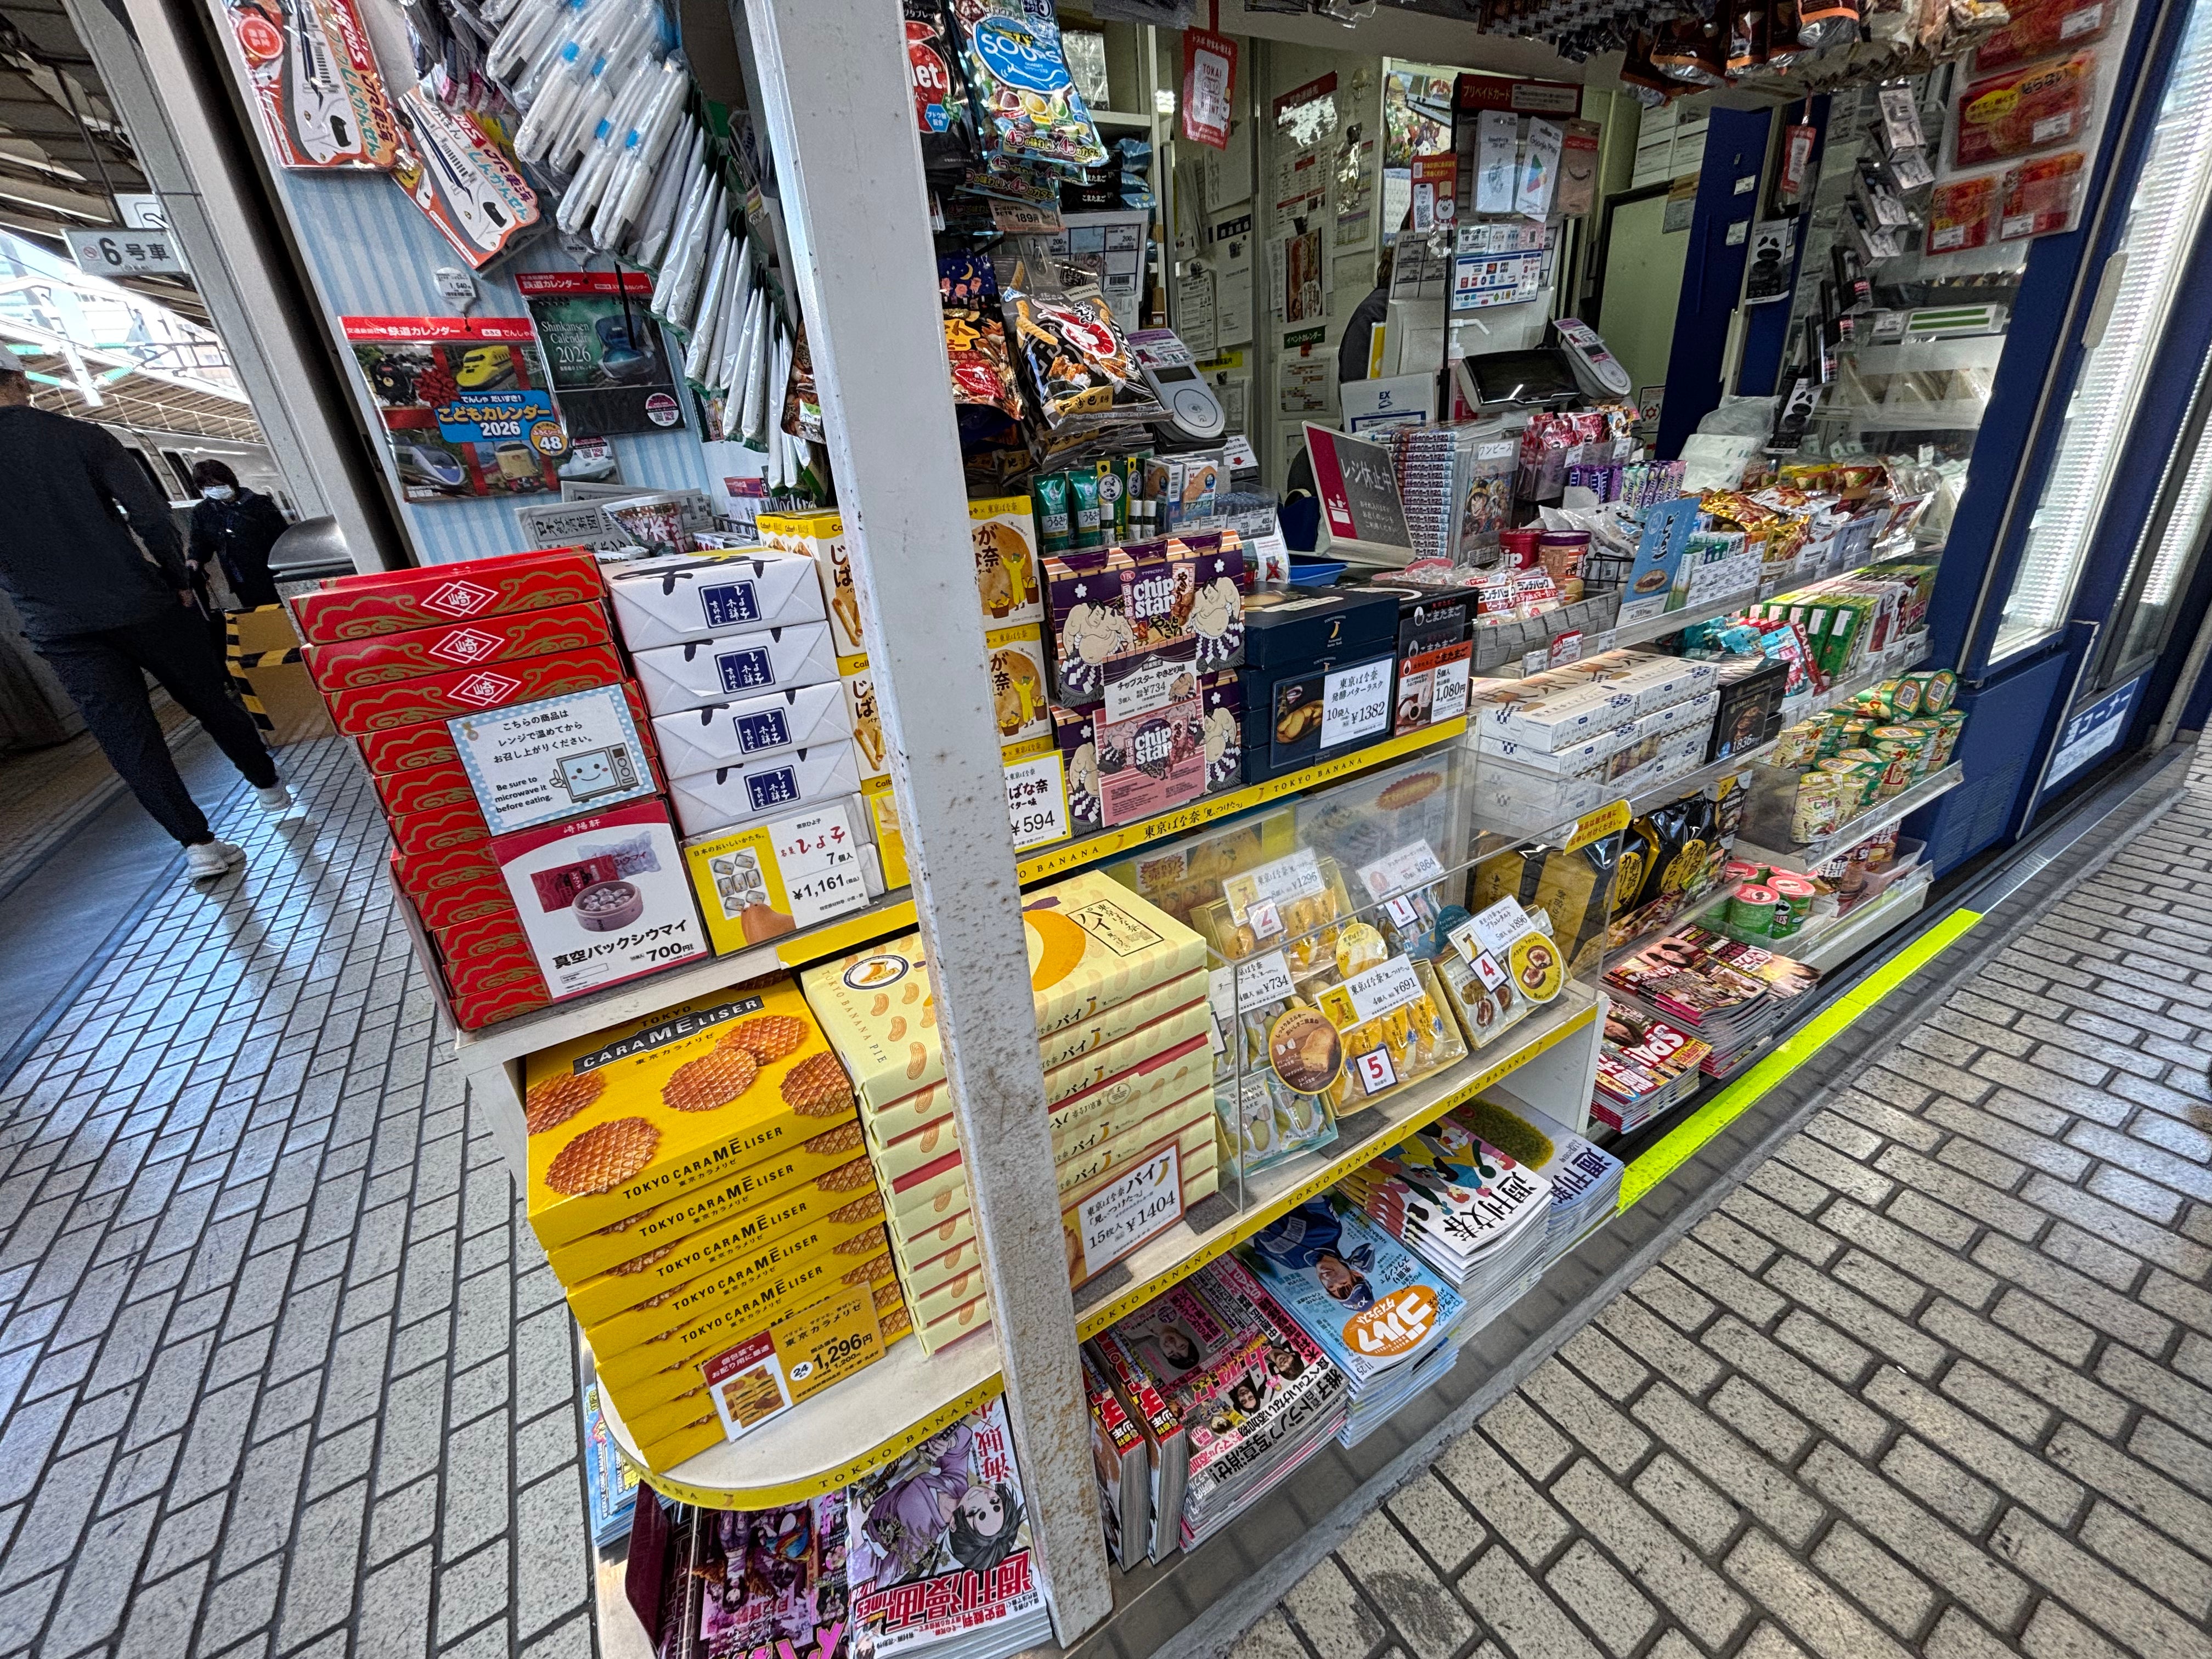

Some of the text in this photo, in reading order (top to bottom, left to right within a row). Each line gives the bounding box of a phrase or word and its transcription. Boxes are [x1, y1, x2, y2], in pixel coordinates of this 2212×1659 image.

[341, 67, 381, 157] しんかんせん
[361, 74, 395, 143] JR東海
[468, 151, 527, 220] しんかんせん
[484, 149, 533, 202] JR東海
[99, 238, 171, 266] 6号車
[523, 280, 580, 289] 鉄道カレンダー
[388, 327, 461, 336] 鉄道カレンダー
[541, 321, 589, 331] Shinkansen
[550, 333, 588, 343] Calendar
[1286, 332, 1322, 344] イベントカレンダー
[556, 347, 591, 363] 2026
[1379, 391, 1390, 400] EX
[438, 404, 550, 422] こどもカレンダー
[480, 422, 521, 436] 2026
[540, 437, 562, 450] 48
[1479, 443, 1513, 456] ワンピース
[1341, 459, 1392, 493] レジ休止中
[1133, 576, 1175, 601] chip
[1479, 586, 1515, 601] ランチパック
[1517, 579, 1549, 591] ランチパック
[1135, 595, 1176, 619] star
[1486, 600, 1515, 611] ピーナッツ
[1118, 665, 1186, 690] チップスター やきとり味
[1340, 667, 1378, 689] 東京ばな奈
[1437, 668, 1451, 678] 8個入
[1143, 681, 1166, 695] ¥734
[1331, 680, 1384, 703] 発酵バターラスク
[1436, 681, 1466, 703] 1,080円
[1118, 696, 1131, 705] 3個入
[503, 710, 569, 730] こちらの商品は
[1327, 708, 1350, 721] 10袋入
[1351, 701, 1385, 724] ¥1382
[498, 722, 582, 747] レンジで温めてから
[1135, 727, 1172, 749] chip
[493, 736, 592, 763] お召し上がりください。
[1136, 741, 1173, 765] star
[509, 780, 526, 789] sure
[1009, 768, 1035, 779] 東京ばな奈
[1274, 757, 1362, 792] TOKYO BANANA
[495, 788, 539, 803] microwave
[1009, 778, 1048, 800] ばな奈
[496, 796, 552, 812] before eating.
[563, 819, 601, 833] 崎陽軒
[797, 819, 821, 829] 東京ひよ子
[1012, 810, 1055, 836] ¥594
[1143, 808, 1200, 838] 東京ばな奈
[693, 834, 764, 857] 日本のおいしいかたち。
[795, 826, 845, 854] ひよ子
[1037, 847, 1099, 872] BANANA
[1417, 857, 1436, 873] ¥864
[792, 874, 844, 900] ¥1,161
[1291, 872, 1317, 889] ¥1296
[1077, 907, 1111, 931] パイ
[1510, 915, 1528, 930] ¥896
[552, 919, 686, 969] 真空パックシウマイ
[1481, 959, 1494, 977] 4
[1263, 974, 1289, 991] ¥734
[1350, 975, 1384, 995] 東京ばな奈
[1393, 978, 1417, 994] ¥691
[1373, 995, 1387, 1005] 4個入
[642, 1006, 691, 1026] TOKYO
[822, 970, 888, 1064] TOKYO BANANA PIE
[1055, 1009, 1081, 1029] パイ
[636, 1034, 714, 1065] 東京カラメリゼ
[1061, 1040, 1086, 1061] パイ
[1624, 1025, 1684, 1066] SPA!
[1367, 1057, 1384, 1079] 5
[1064, 1077, 1090, 1097] パイ
[1446, 1054, 1527, 1108] TOKYO BANANA
[1071, 1136, 1095, 1155] パイ
[679, 1159, 737, 1187] 東京カラメリゼ
[1074, 1163, 1097, 1183] パイ
[1288, 1139, 1388, 1206] TOKYO BANANA
[623, 1176, 670, 1199] TOKYO
[1087, 1164, 1155, 1217] 東京ばな奈 パイ
[693, 1196, 749, 1224] 東京カラメリゼ
[1126, 1190, 1175, 1232] ¥1404
[1443, 1171, 1538, 1242] 週刊文春
[639, 1213, 685, 1237] TOKYO
[1089, 1223, 1123, 1249] 15枚入
[709, 1234, 763, 1262] 東京カラメリゼ
[656, 1253, 700, 1277] TOKYO
[723, 1266, 776, 1295] 東京カラメリゼ
[1086, 1295, 1139, 1332] TOKYO
[1149, 1250, 1212, 1292] BANANA
[672, 1286, 715, 1310] TOKYO
[730, 1299, 782, 1328] 東京カラメリゼ
[785, 1303, 861, 1347] 東京カラメリゼ
[1358, 1293, 1432, 1352] ゴルフ
[680, 1318, 722, 1343] TOKYO
[712, 1346, 769, 1379] お配り用に最適
[721, 1344, 754, 1364] 個包装で
[814, 1333, 873, 1369] 1,296円
[793, 1364, 809, 1377] 24
[1317, 1368, 1344, 1404] 雅子
[820, 1390, 989, 1489] TOKYO BANANA
[887, 1550, 1035, 1633] 週刊漫画
[856, 1590, 895, 1620] TIMES
[963, 1603, 1007, 1629] 歴史裁判
